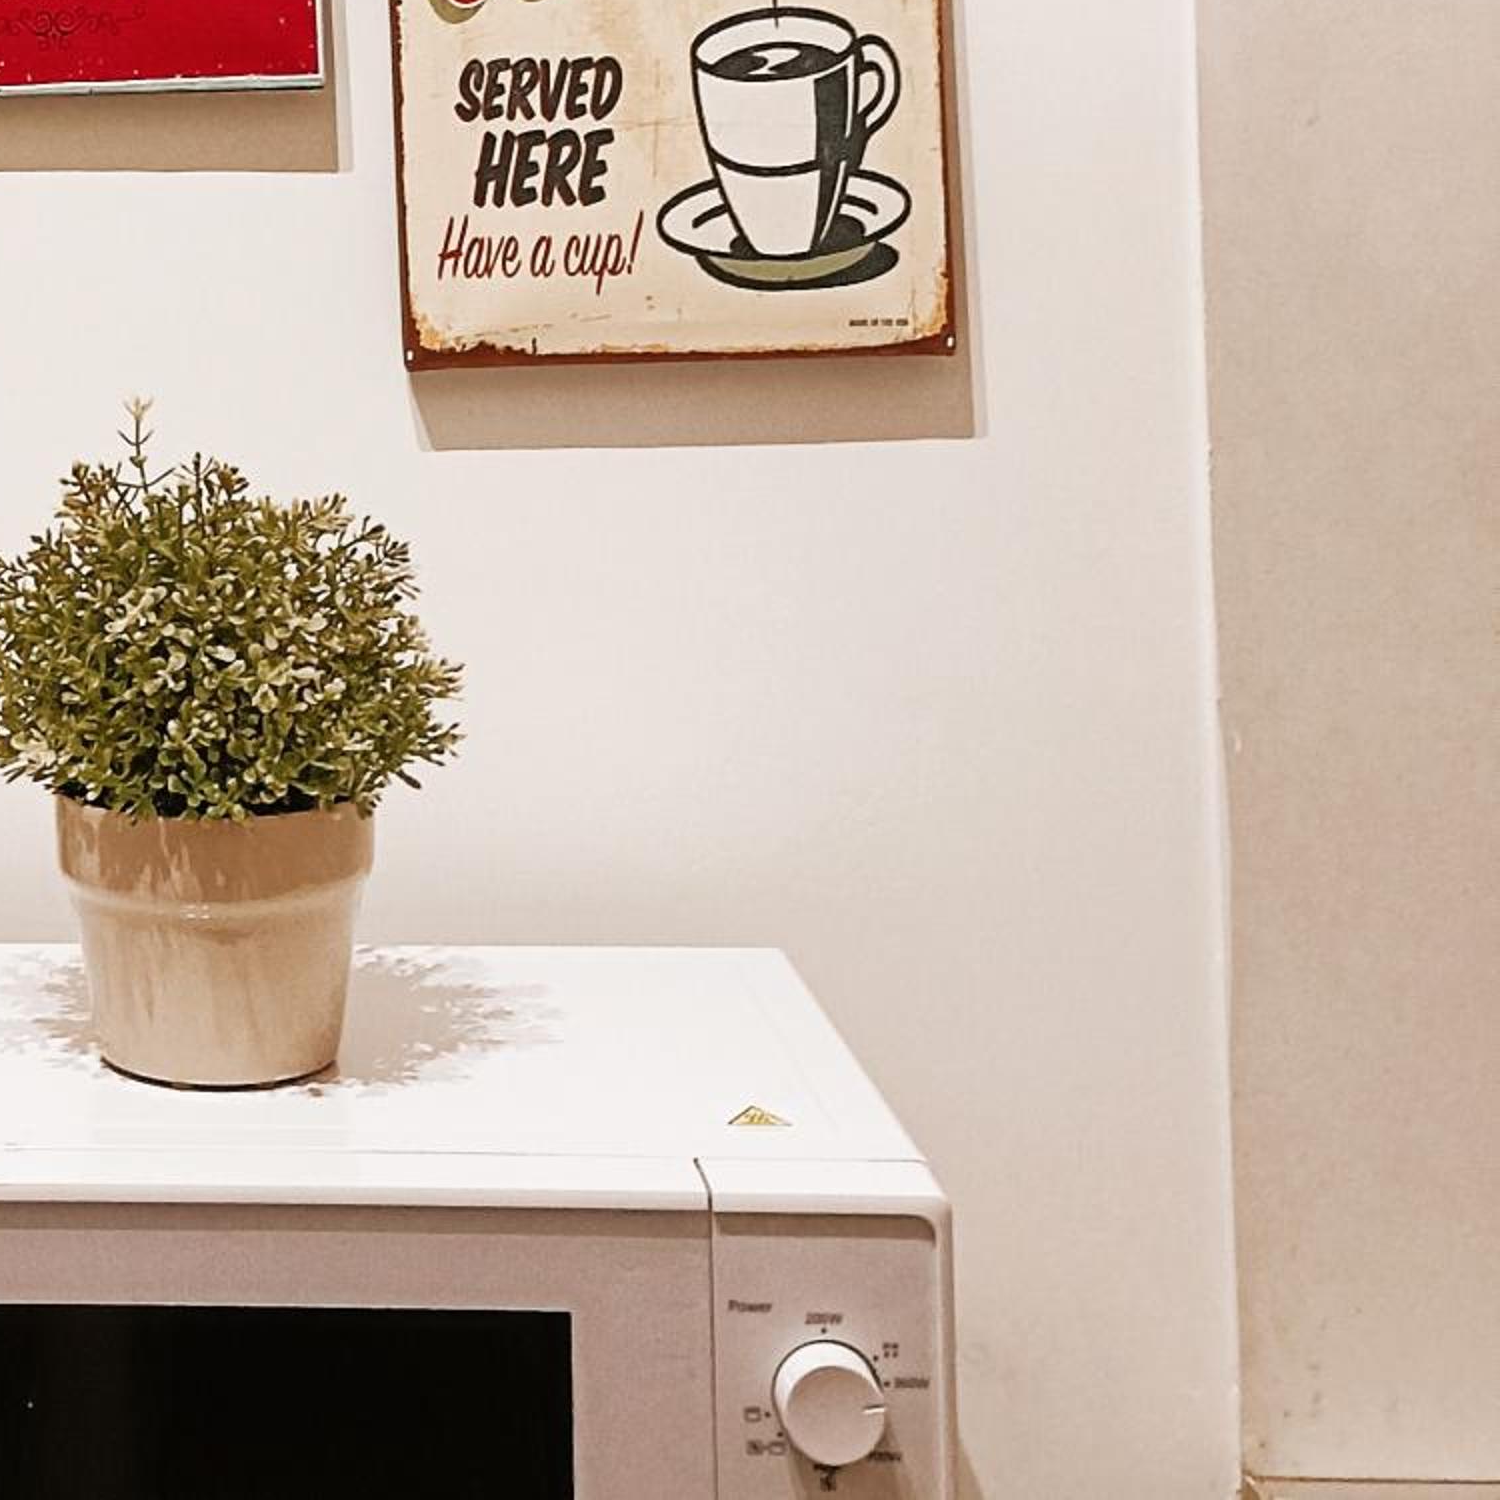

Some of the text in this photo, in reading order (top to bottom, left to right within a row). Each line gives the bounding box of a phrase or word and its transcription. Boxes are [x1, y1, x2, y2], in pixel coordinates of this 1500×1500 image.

[453, 56, 623, 122] SERVED
[473, 129, 614, 208] HERE
[437, 210, 645, 295] Have a cup!
[727, 1299, 772, 1314] Power
